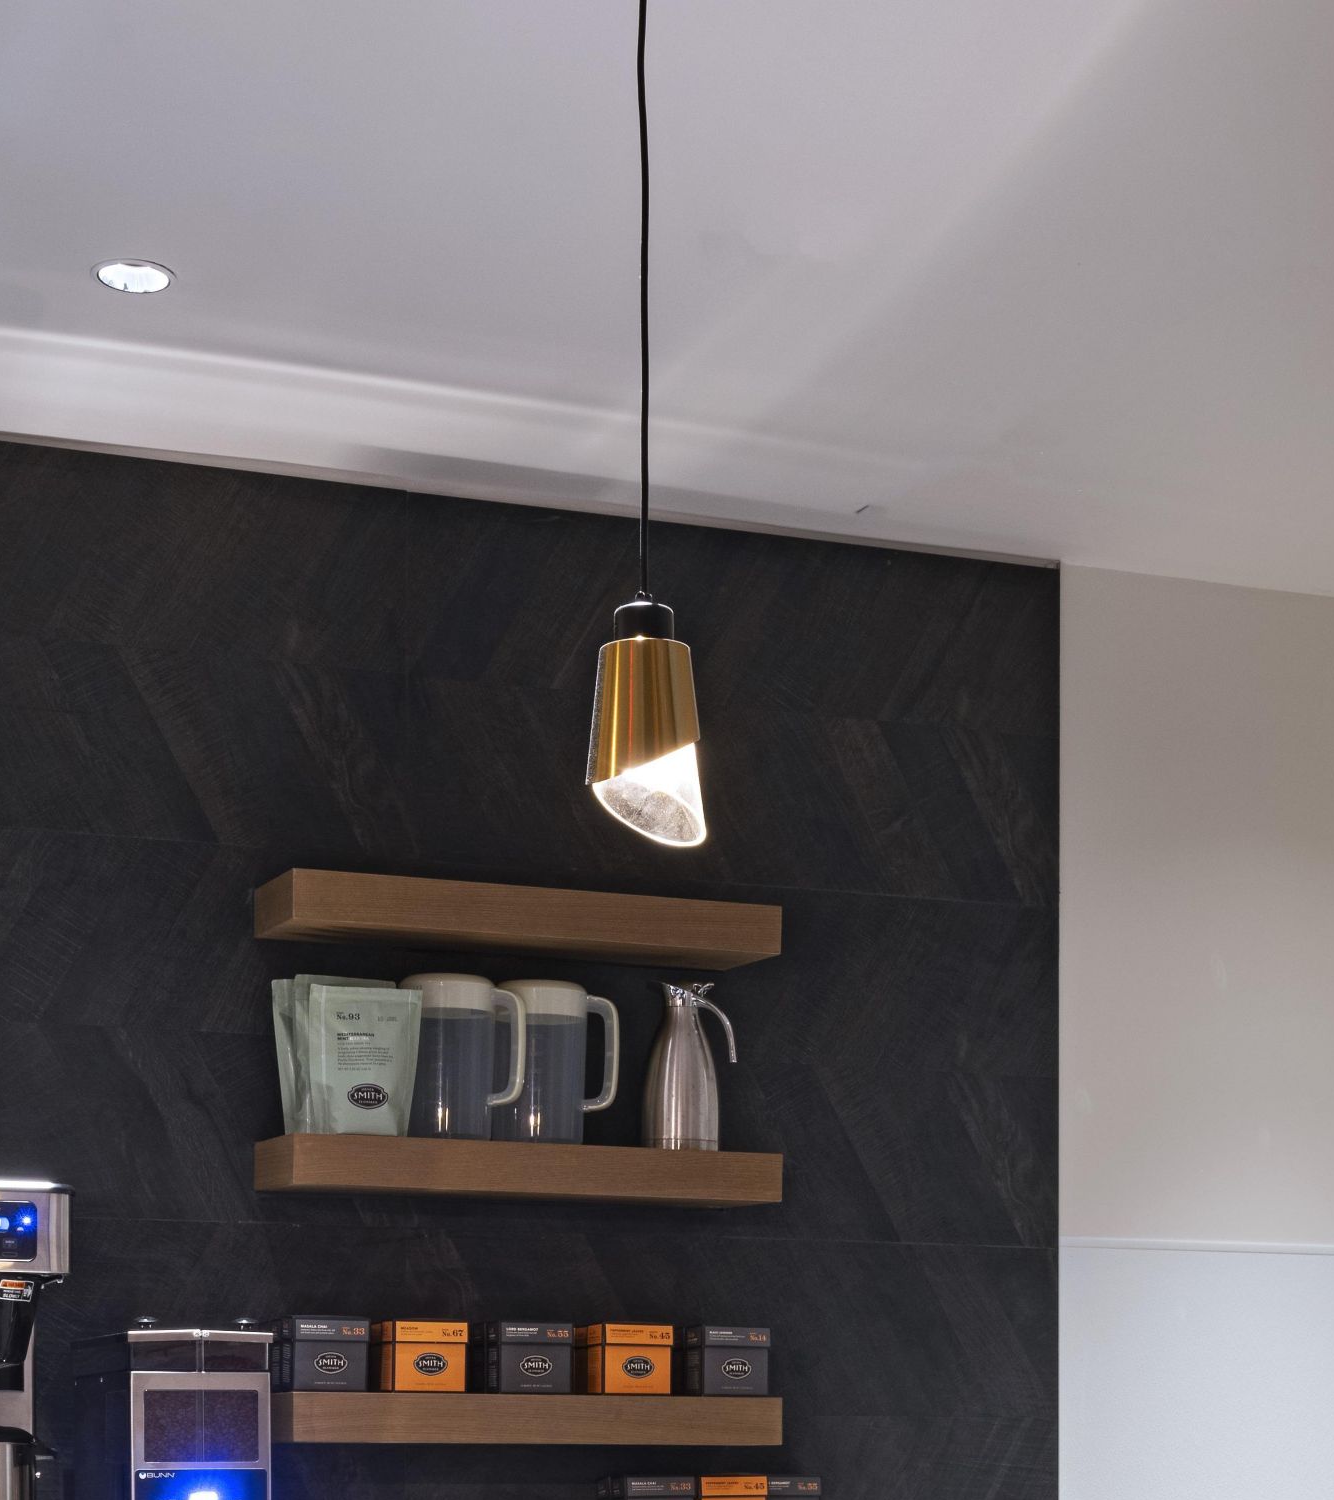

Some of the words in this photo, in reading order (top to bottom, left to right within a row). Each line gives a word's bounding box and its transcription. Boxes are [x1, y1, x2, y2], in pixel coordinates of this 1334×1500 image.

[354, 1091, 383, 1100] SMITH
[418, 1360, 444, 1368] SMITH
[524, 1361, 549, 1369] SMITH
[627, 1363, 650, 1371] SMITH
[725, 1364, 748, 1372] SMITH
